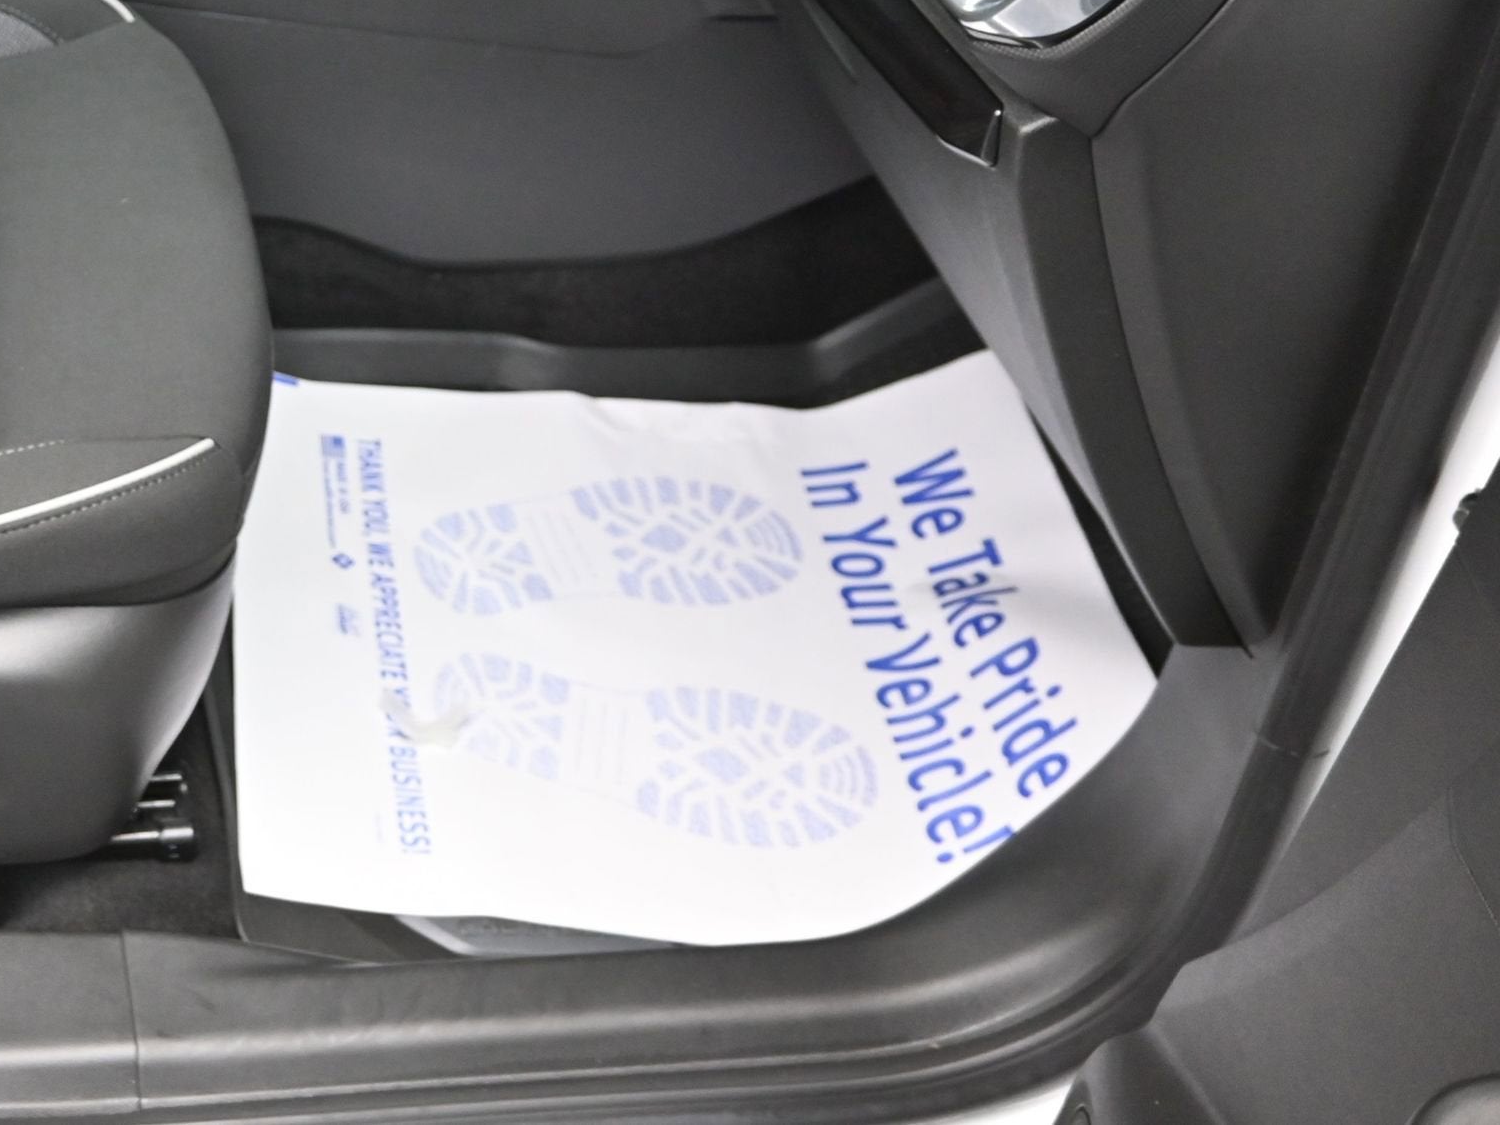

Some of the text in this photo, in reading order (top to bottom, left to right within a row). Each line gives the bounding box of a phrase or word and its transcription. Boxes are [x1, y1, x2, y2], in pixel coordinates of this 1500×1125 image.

[359, 439, 384, 492] THANK
[367, 541, 395, 569] WE
[372, 573, 408, 680] APPRECIATE
[800, 461, 1015, 864] In Your Vehicle!
[894, 448, 1078, 798] We Take Pride
[389, 746, 432, 855] BUSINESS!
